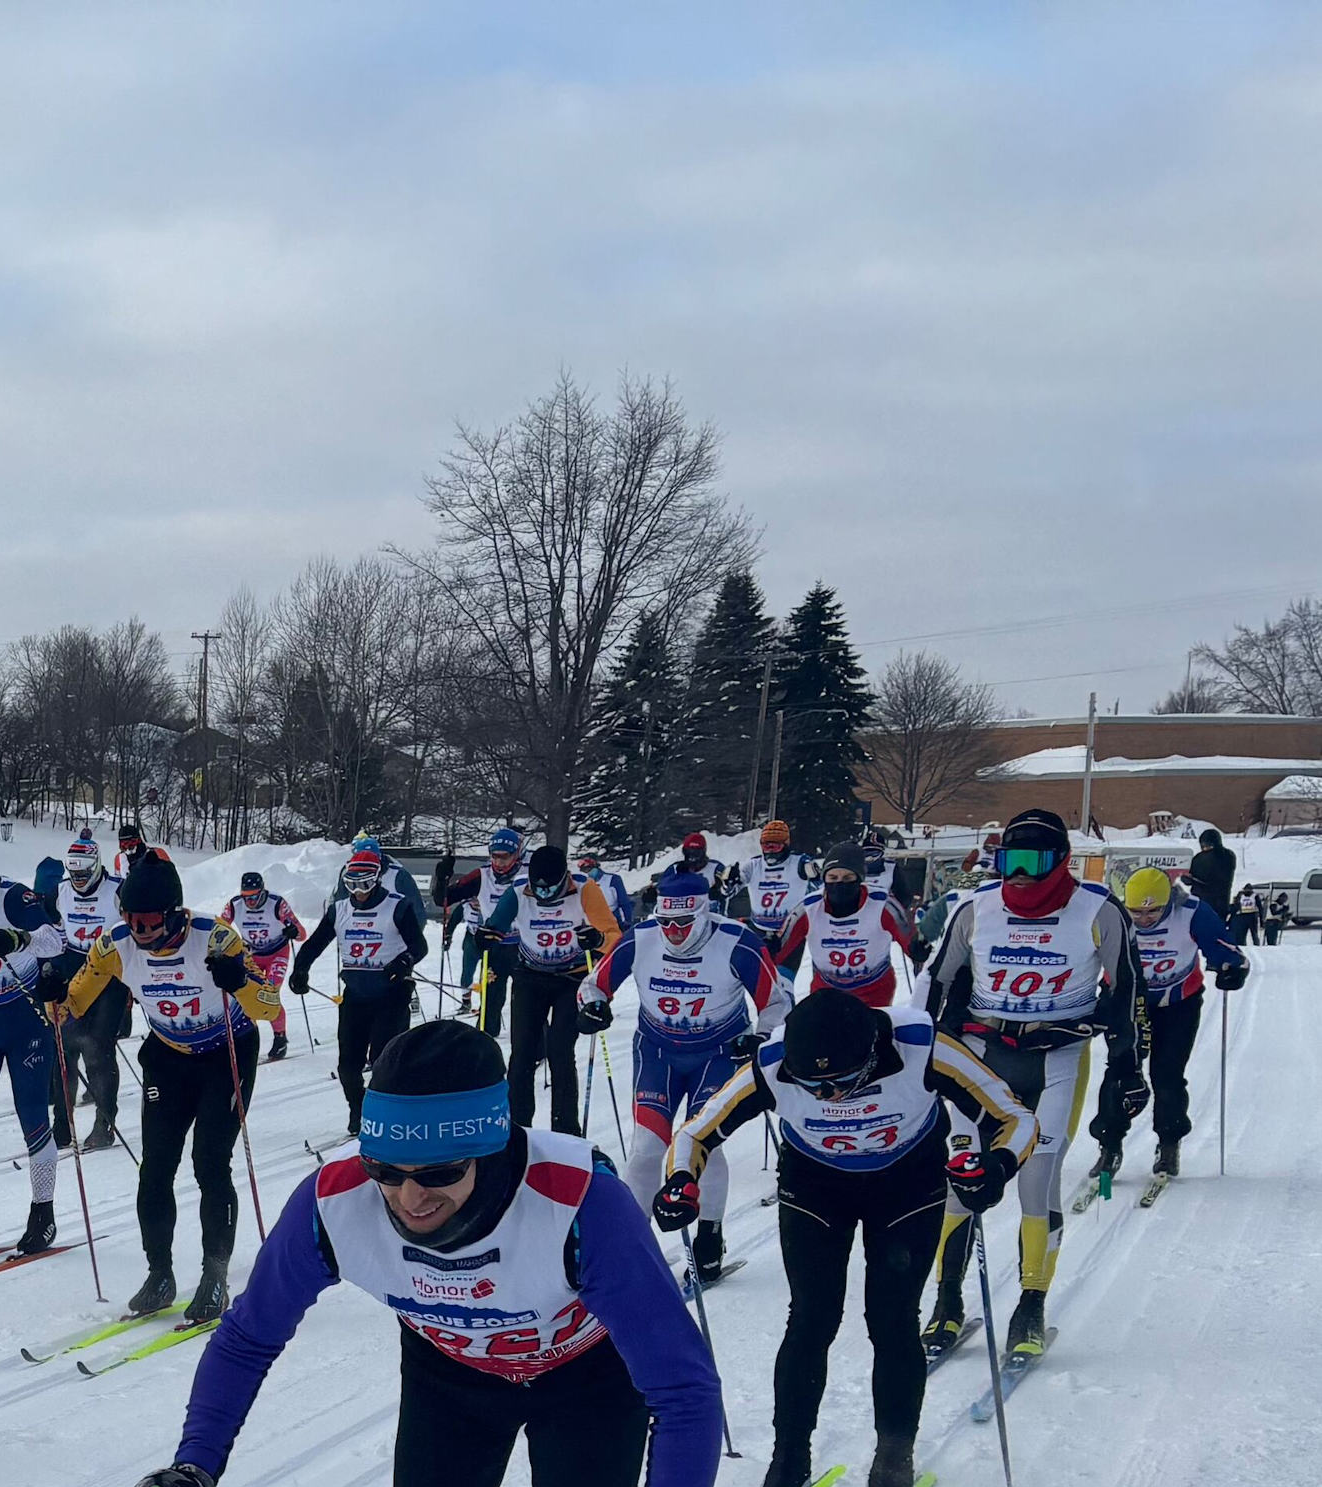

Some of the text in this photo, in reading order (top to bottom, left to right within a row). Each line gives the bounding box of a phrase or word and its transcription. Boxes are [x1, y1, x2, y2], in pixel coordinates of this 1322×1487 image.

[761, 891, 788, 908] 67
[537, 930, 573, 947] 99
[350, 943, 382, 958] 87
[828, 948, 867, 967] 96
[990, 955, 1067, 965] NOQUE 2025
[988, 968, 1075, 998] 101
[156, 997, 201, 1017] 91
[390, 1123, 428, 1141] SKI
[438, 1117, 485, 1139] FEST
[412, 1275, 470, 1297] Honor
[470, 1312, 535, 1329] 2025
